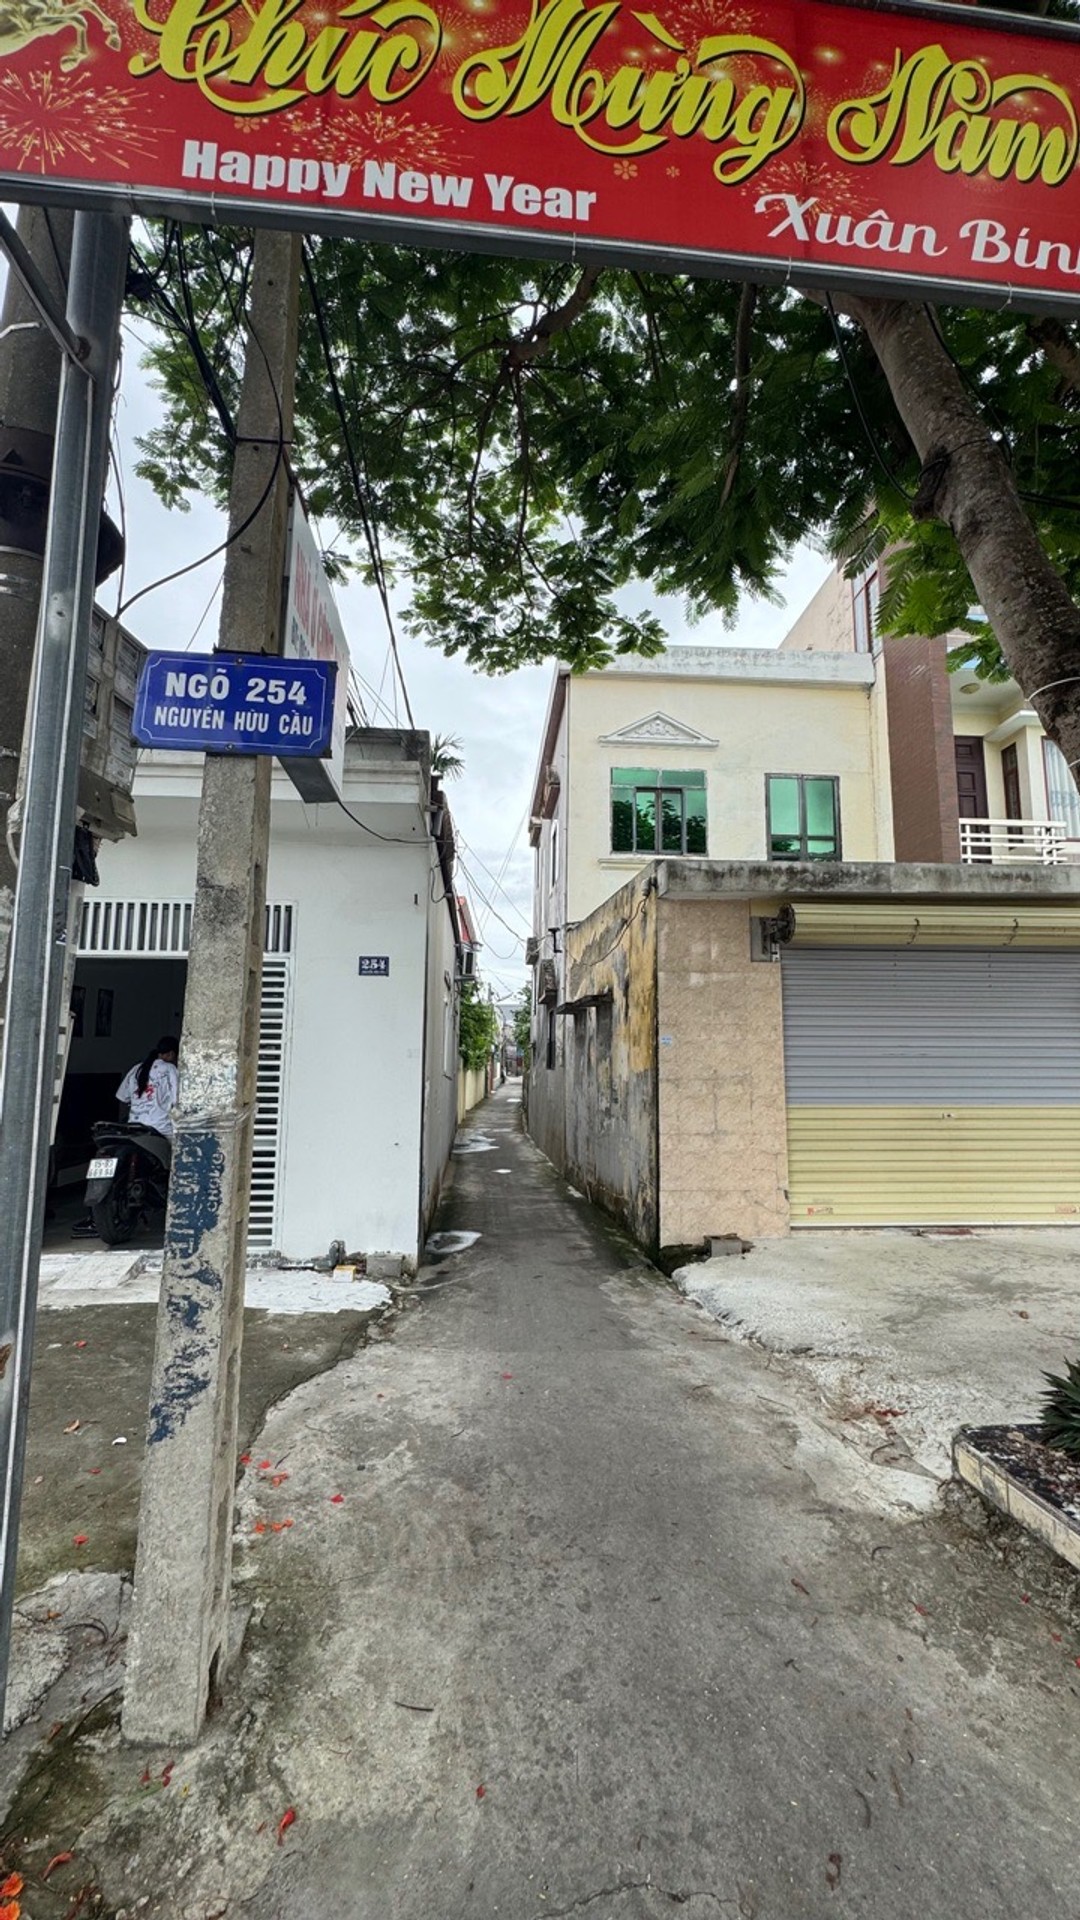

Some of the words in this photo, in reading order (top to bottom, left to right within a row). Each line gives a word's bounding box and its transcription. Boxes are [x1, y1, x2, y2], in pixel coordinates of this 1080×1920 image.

[452, 0, 807, 187] Mừng
[181, 139, 351, 198] Happy
[363, 160, 474, 209] New
[484, 173, 597, 222] Year
[754, 193, 949, 257] Xuân
[959, 219, 1080, 275] Bín
[165, 668, 230, 700] NGÕ
[245, 677, 307, 706] 254
[278, 709, 314, 736] CẦU
[361, 958, 386, 969] 254
